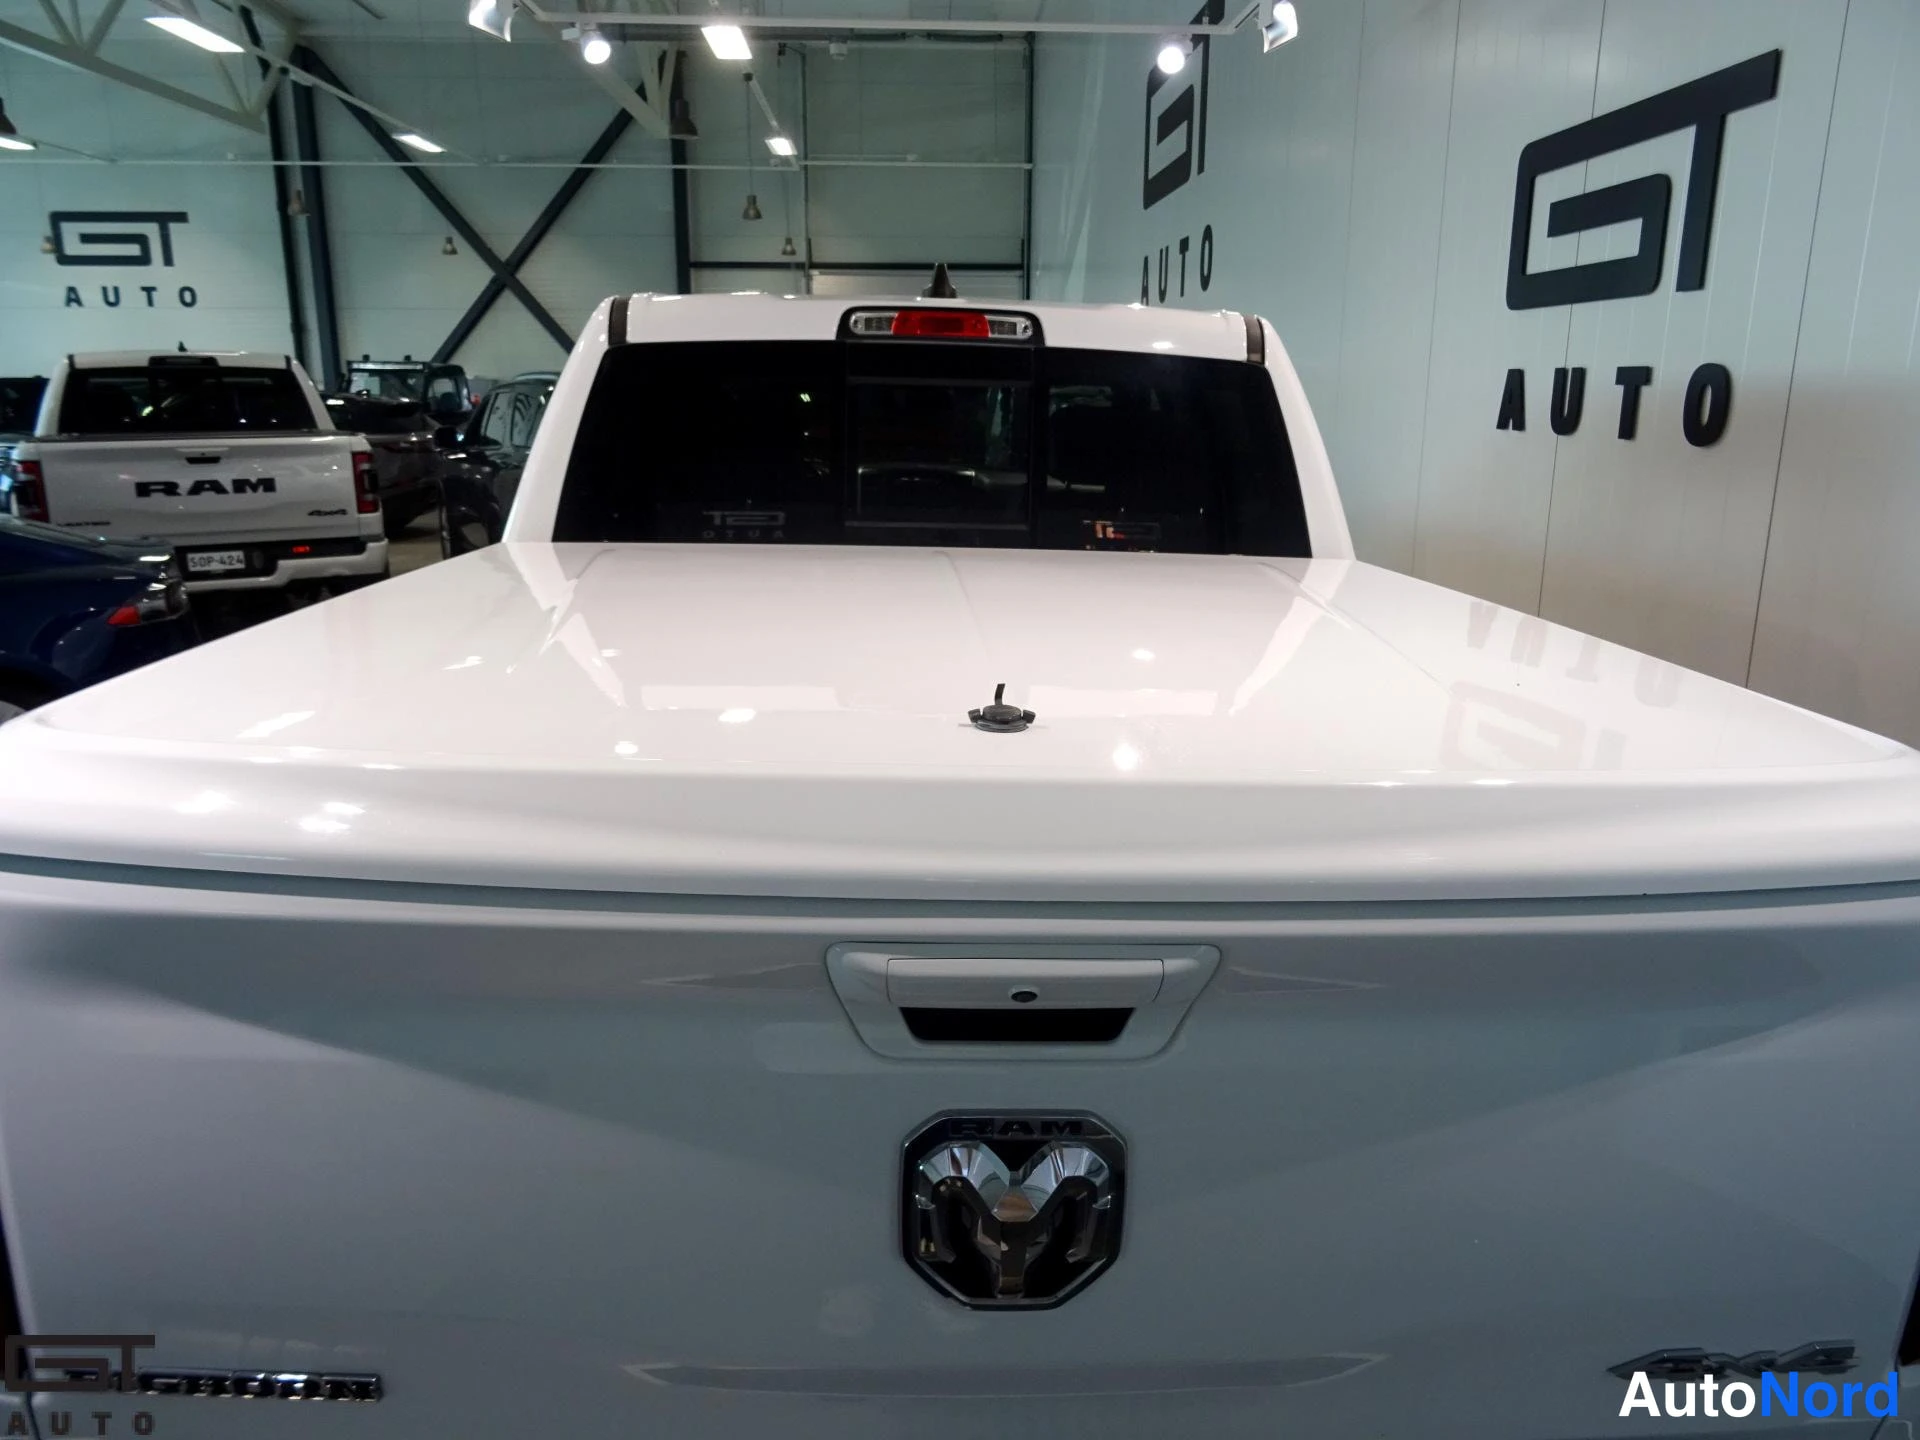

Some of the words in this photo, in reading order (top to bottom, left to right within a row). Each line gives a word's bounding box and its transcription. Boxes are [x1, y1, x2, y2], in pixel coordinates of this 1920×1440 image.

[1506, 48, 1782, 311] GT
[48, 211, 189, 267] GT
[1141, 224, 1214, 306] AUTO
[64, 285, 198, 308] AUTO
[1496, 362, 1732, 448] AUTO
[134, 477, 277, 498] RAM
[949, 1120, 1084, 1137] RAM
